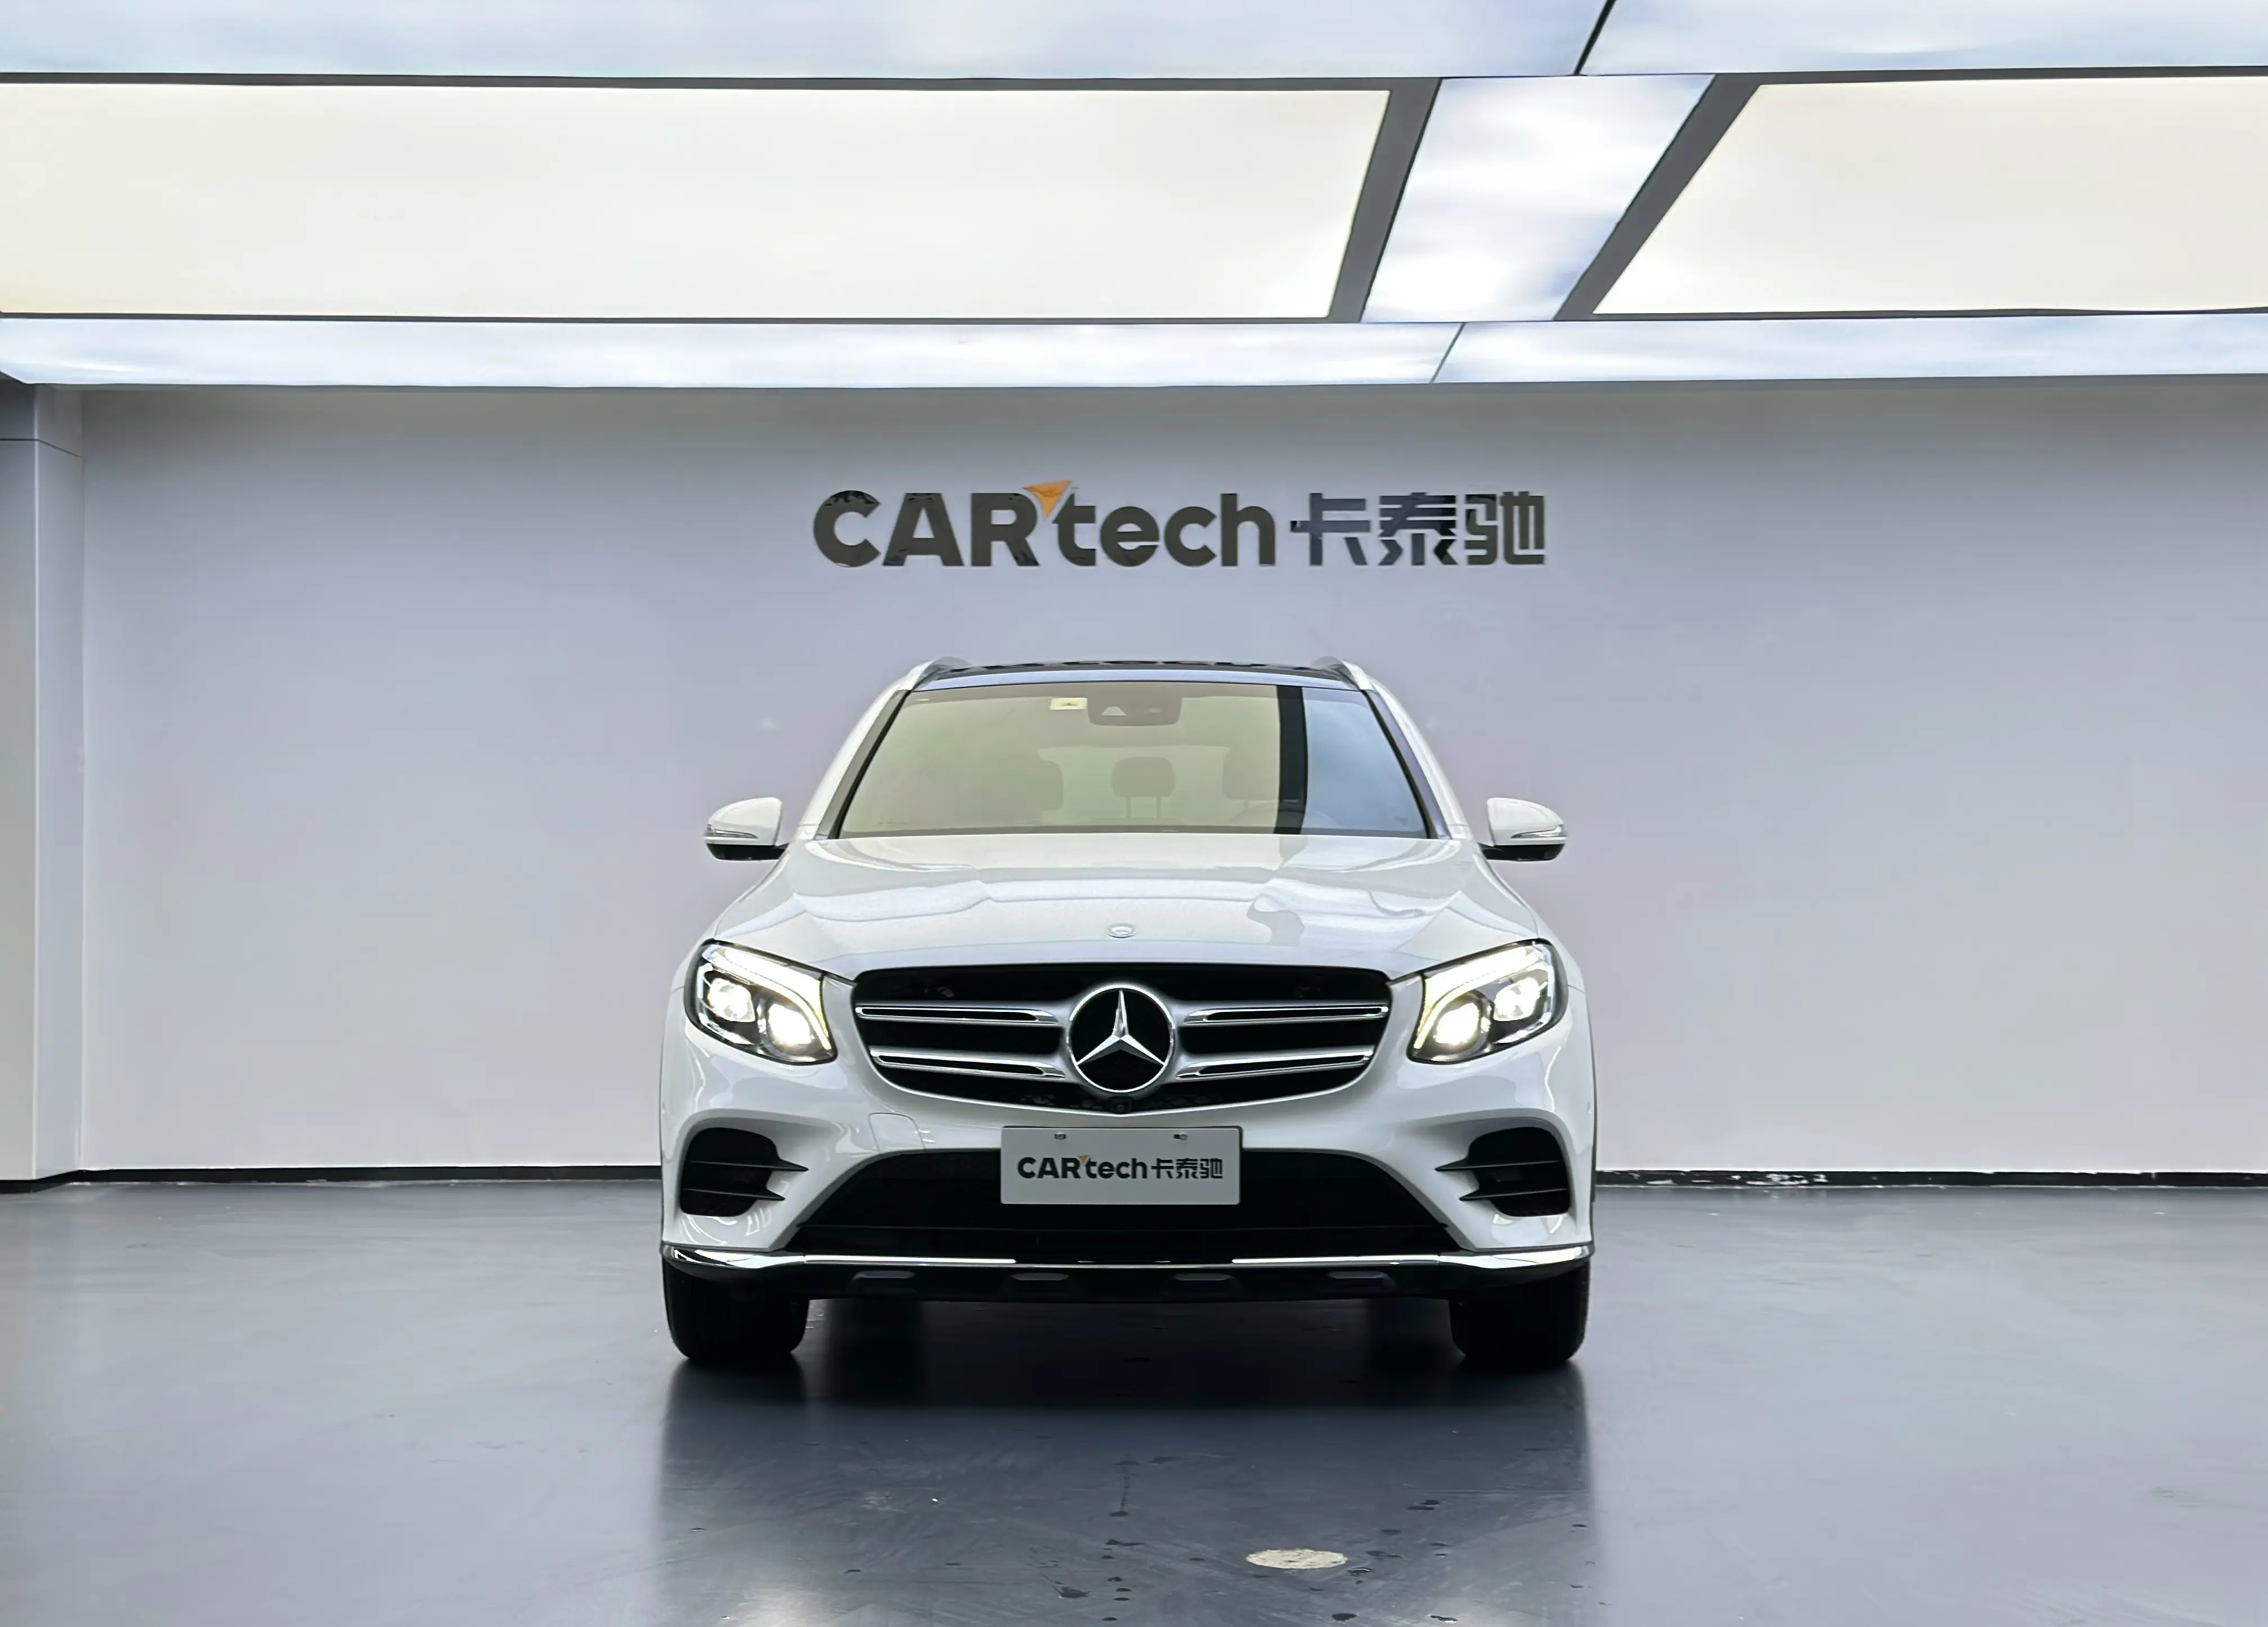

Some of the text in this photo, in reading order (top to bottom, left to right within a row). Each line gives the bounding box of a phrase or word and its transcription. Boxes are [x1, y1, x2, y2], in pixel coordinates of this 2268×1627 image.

[813, 487, 1545, 567] CARtech 卡泰驰
[1017, 1155, 1223, 1180] CARtech 卡泰驰
